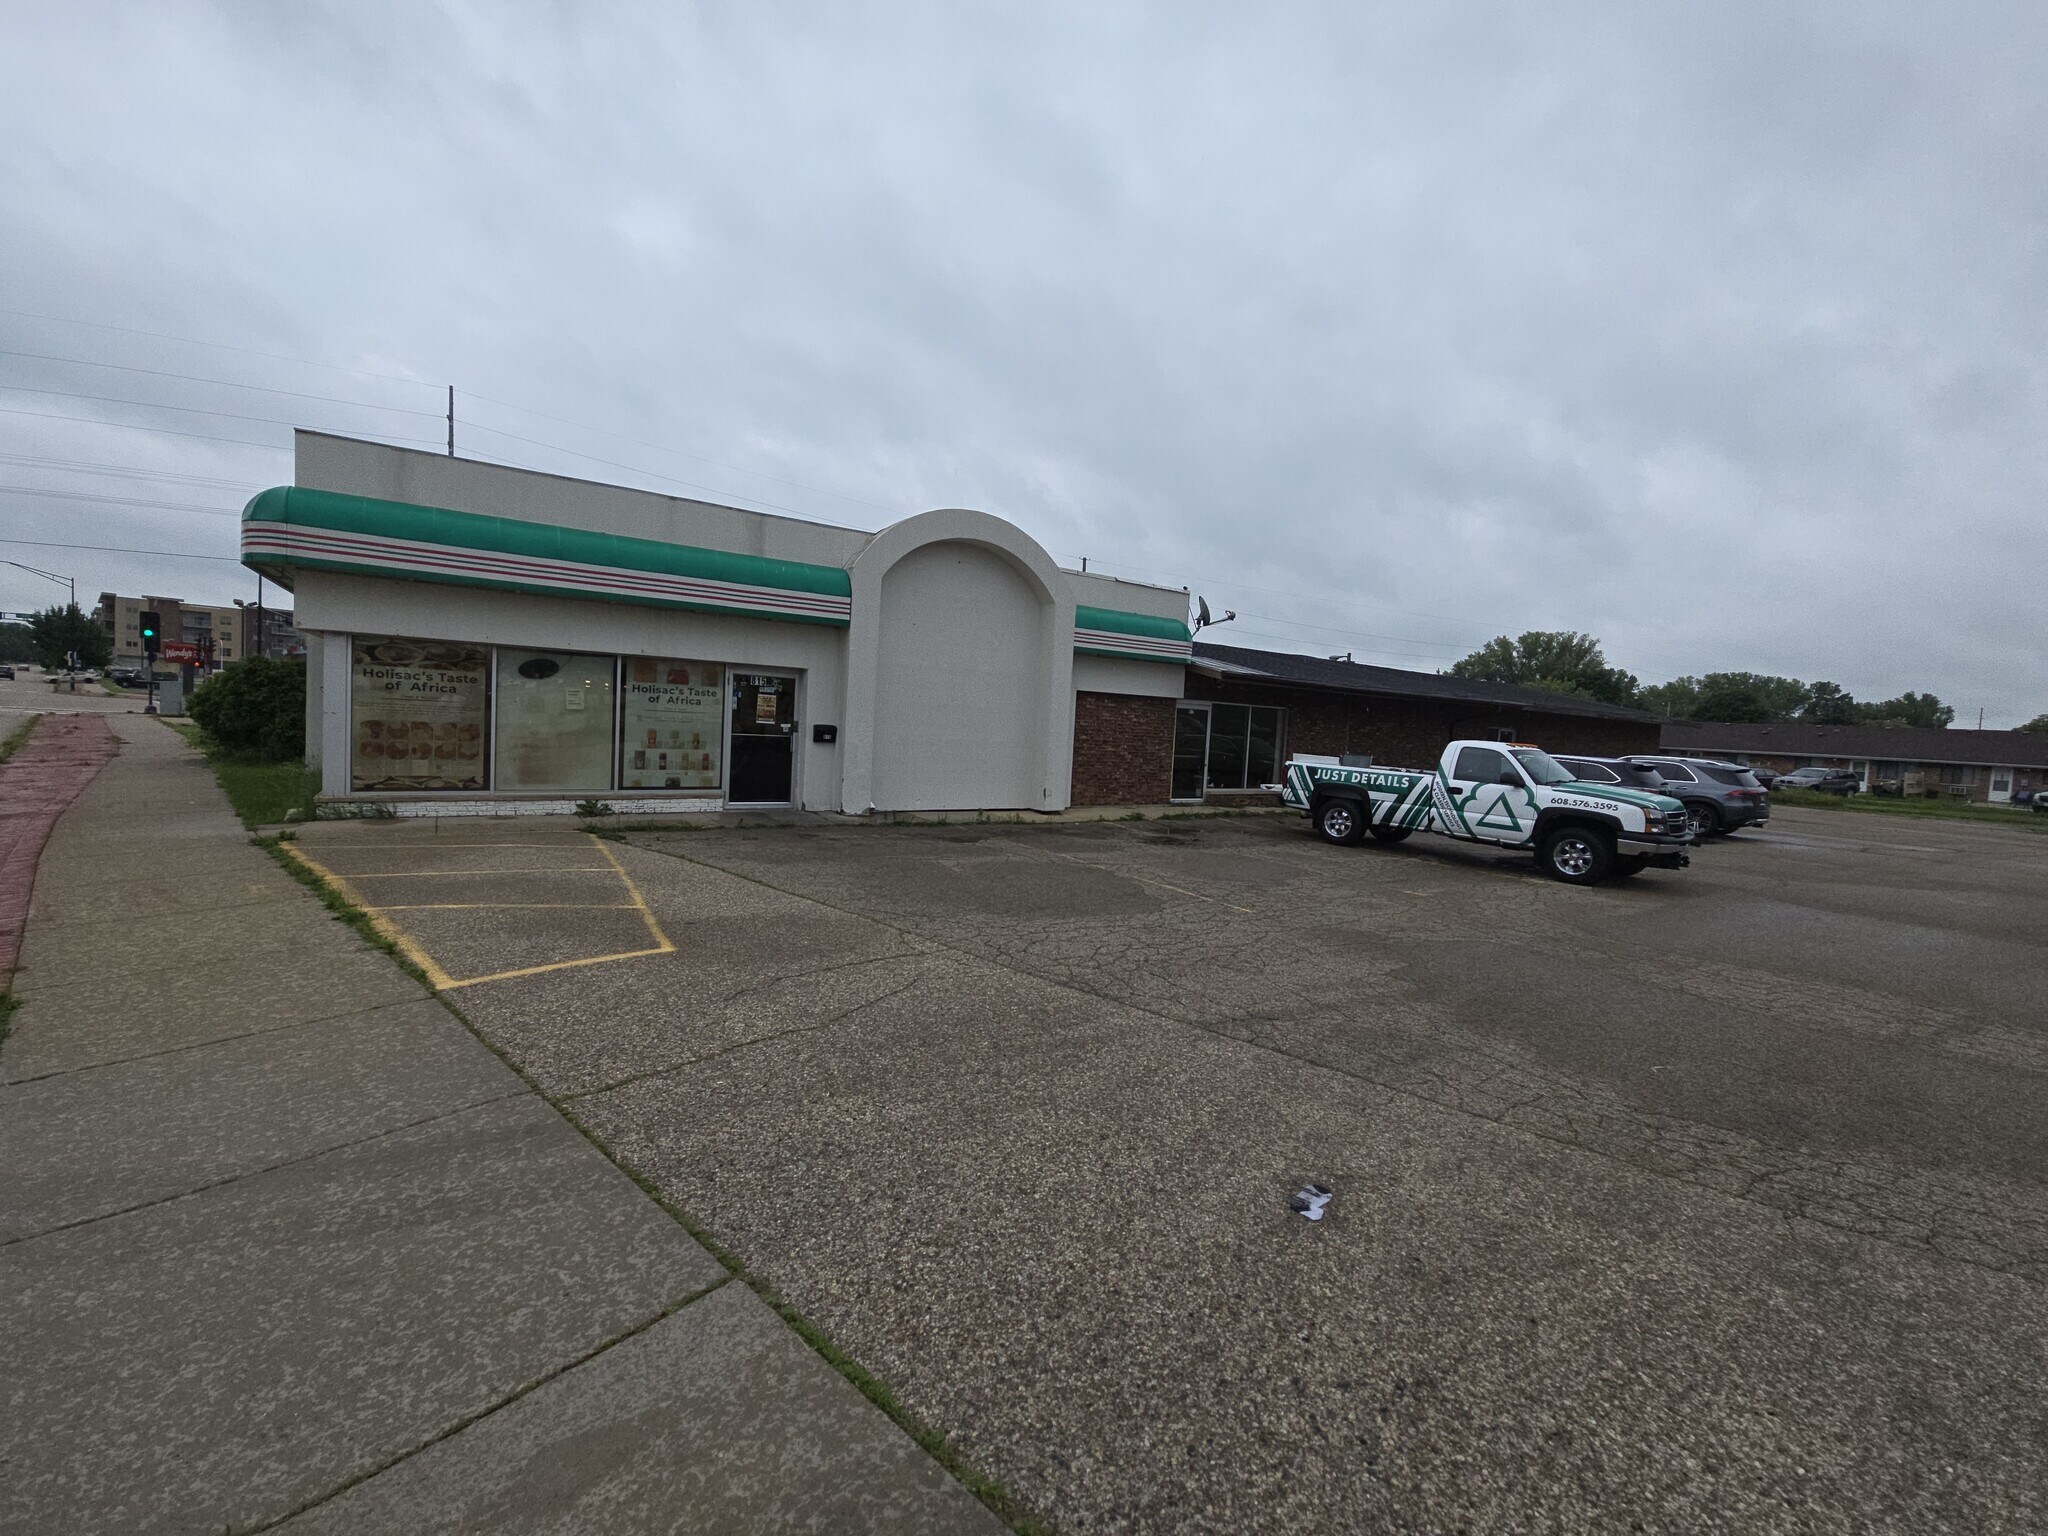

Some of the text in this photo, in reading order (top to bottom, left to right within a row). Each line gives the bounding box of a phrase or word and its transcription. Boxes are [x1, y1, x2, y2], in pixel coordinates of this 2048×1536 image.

[166, 648, 193, 660] Wendy's
[363, 667, 478, 685] Holisac's Taste
[751, 676, 766, 686] 815
[385, 681, 457, 694] of Africa
[632, 684, 718, 698] Holisac's Taste
[648, 695, 702, 706] of Africa
[1314, 768, 1347, 782] JUST
[1351, 772, 1410, 788] DETAILS
[1550, 797, 1619, 811] 608.576.3595
